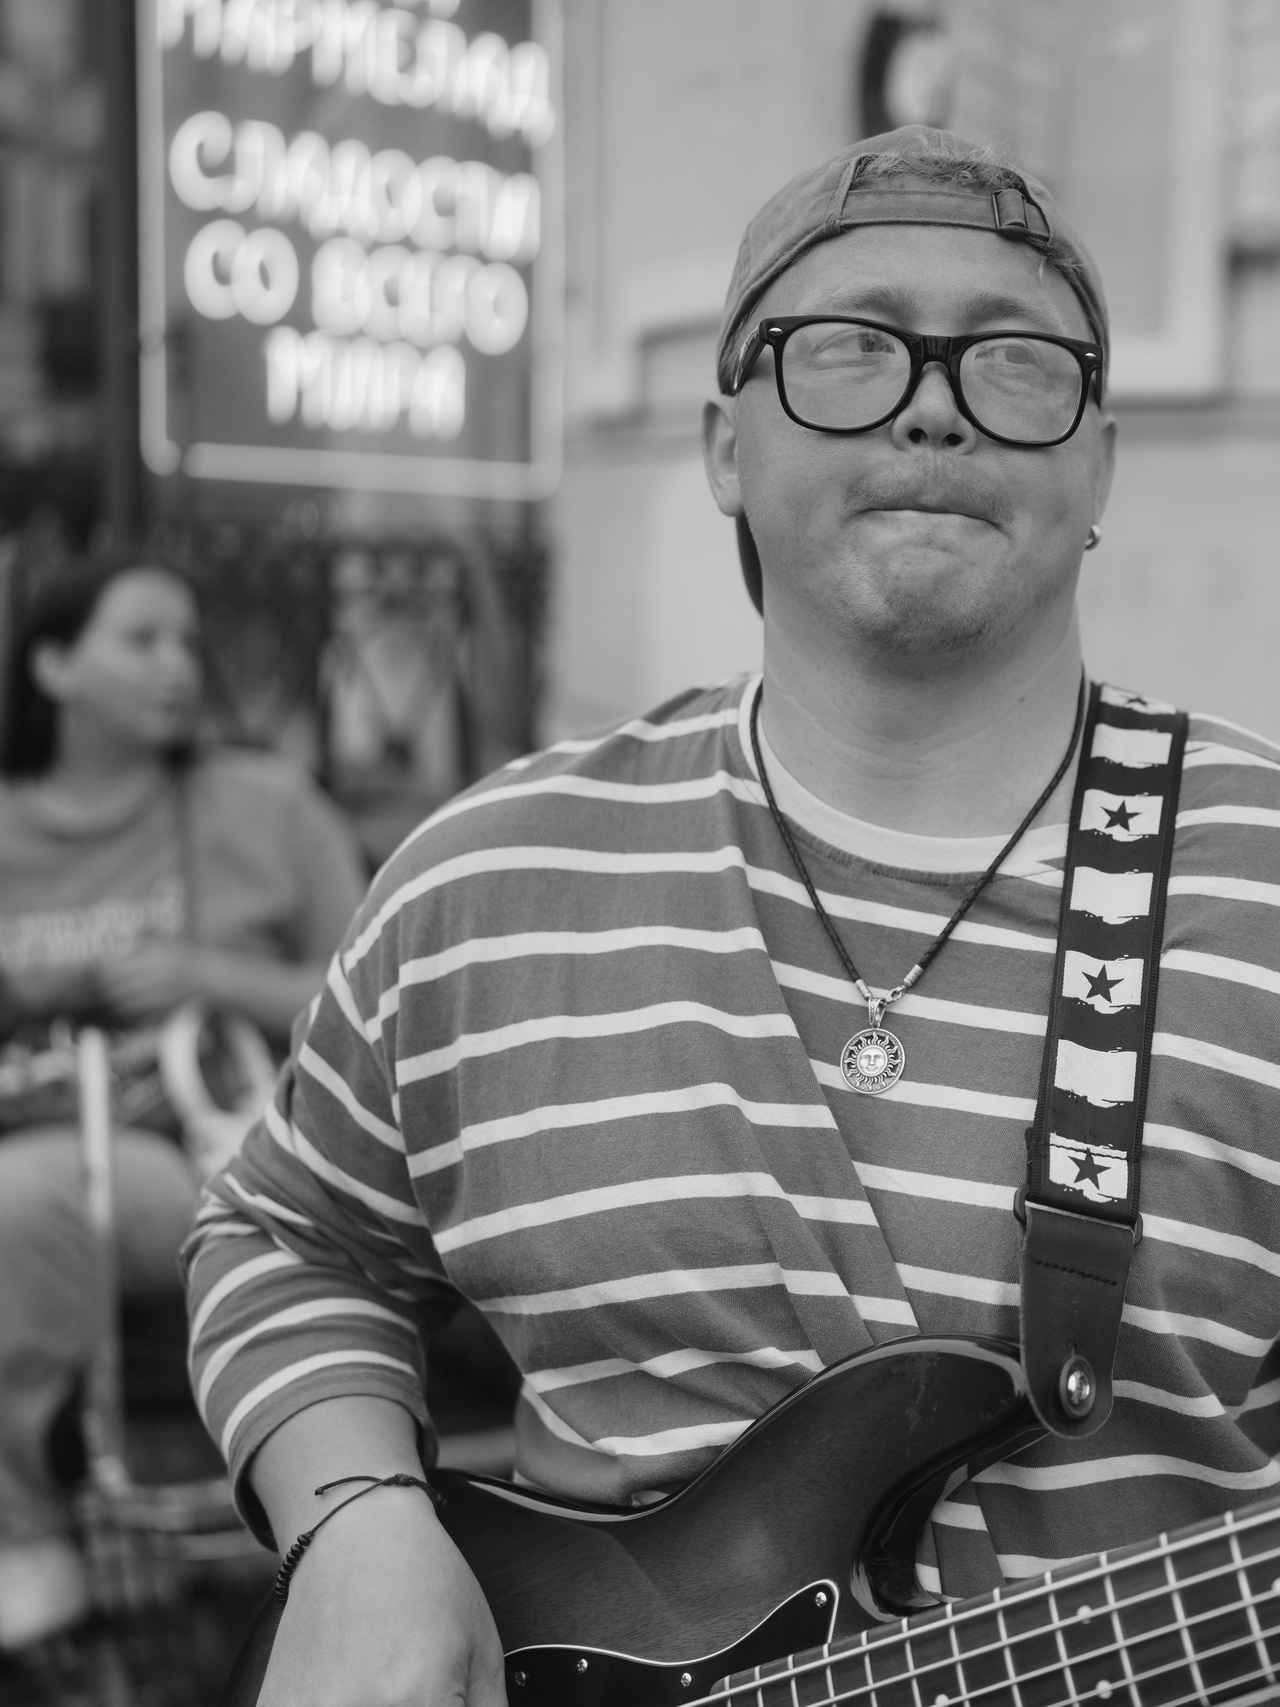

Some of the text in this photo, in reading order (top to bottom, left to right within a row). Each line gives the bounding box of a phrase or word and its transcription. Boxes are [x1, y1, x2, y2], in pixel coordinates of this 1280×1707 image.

[169, 110, 541, 263] СЛАДОСТИ
[184, 219, 528, 356] СО ВСЕГО
[266, 325, 466, 442] МИРА
